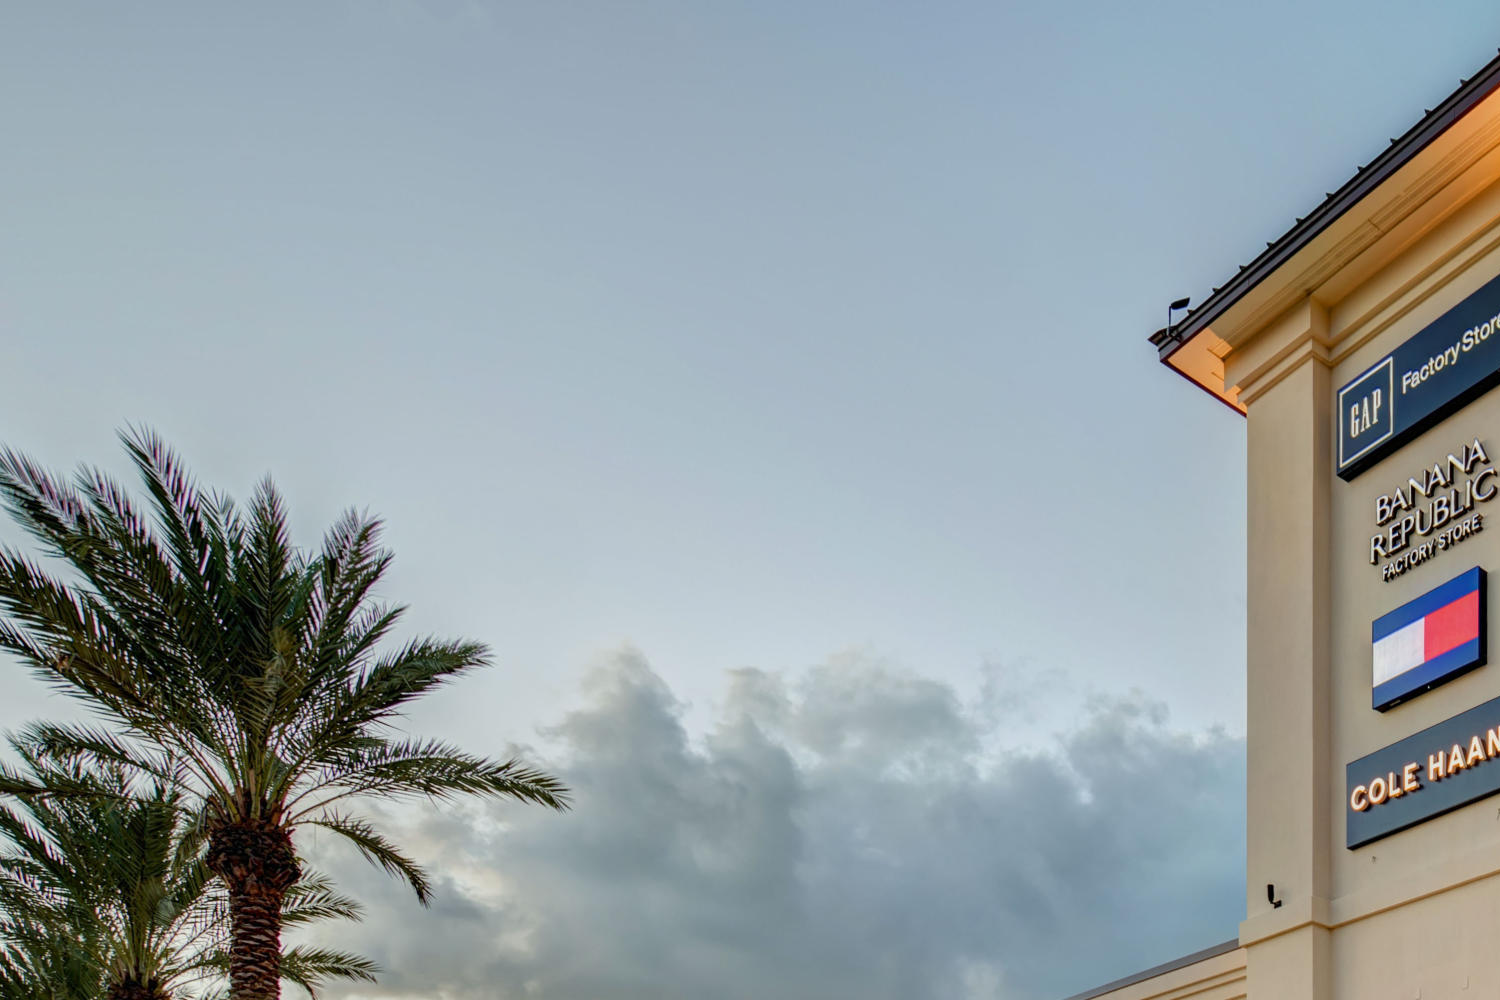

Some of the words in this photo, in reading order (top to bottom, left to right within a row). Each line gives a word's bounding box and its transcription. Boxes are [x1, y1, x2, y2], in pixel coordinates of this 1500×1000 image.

[1402, 341, 1461, 394] Factory
[1350, 388, 1382, 438] GAP
[1376, 437, 1490, 527] BANANA
[1369, 466, 1498, 564] REPUBLIC
[1382, 538, 1436, 583] FACTORY
[1437, 512, 1484, 550] STORE
[1350, 761, 1424, 812] COLE
